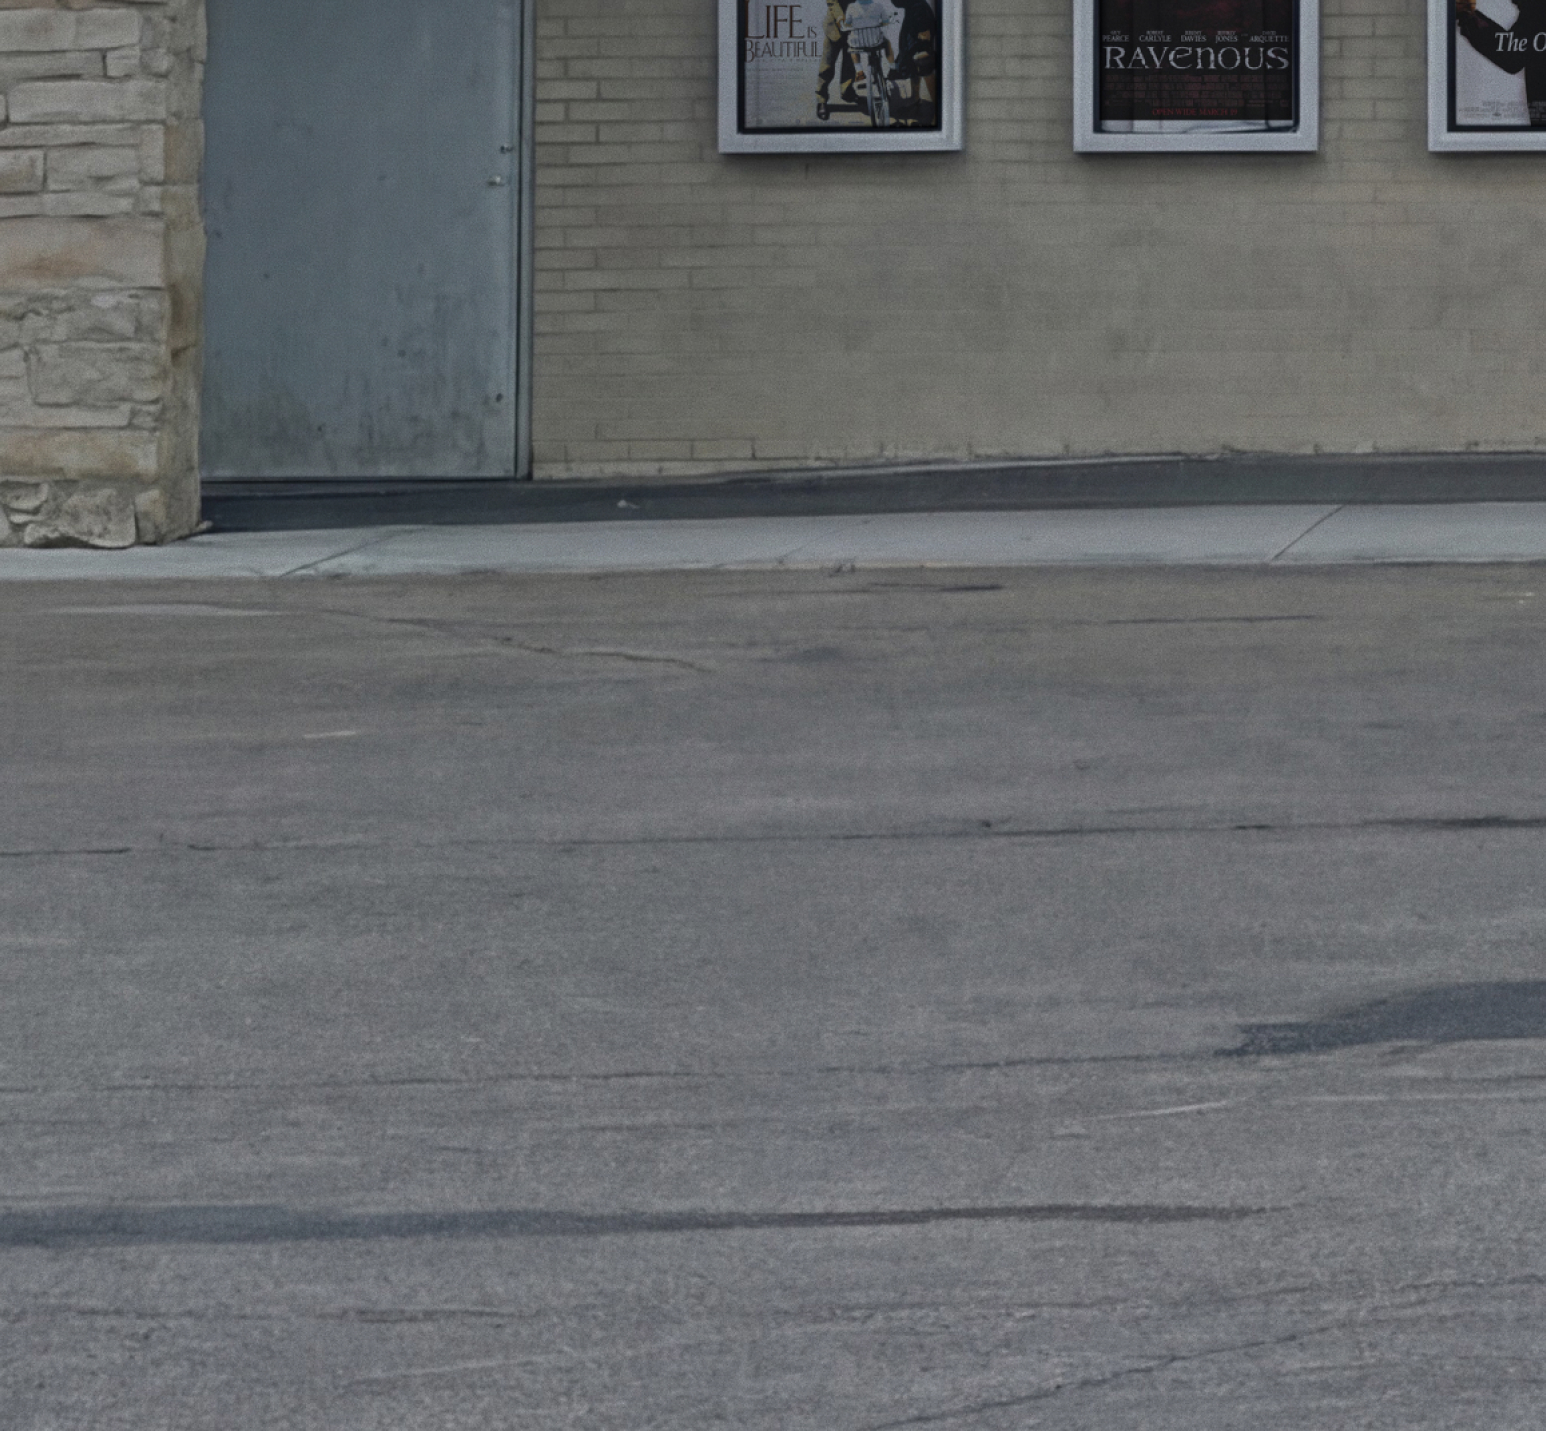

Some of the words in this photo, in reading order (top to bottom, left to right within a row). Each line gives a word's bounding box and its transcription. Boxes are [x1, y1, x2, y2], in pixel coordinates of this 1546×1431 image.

[744, 0, 805, 39] LIFE
[807, 26, 817, 38] IS
[1102, 34, 1130, 43] PEARCE
[1139, 34, 1172, 43] CARLYLE
[1180, 34, 1207, 43] DAVIES
[1215, 34, 1238, 44] JONES
[1249, 34, 1290, 43] ARQUETTE
[1494, 31, 1528, 52] The
[744, 40, 822, 63] BEAUTIFUL
